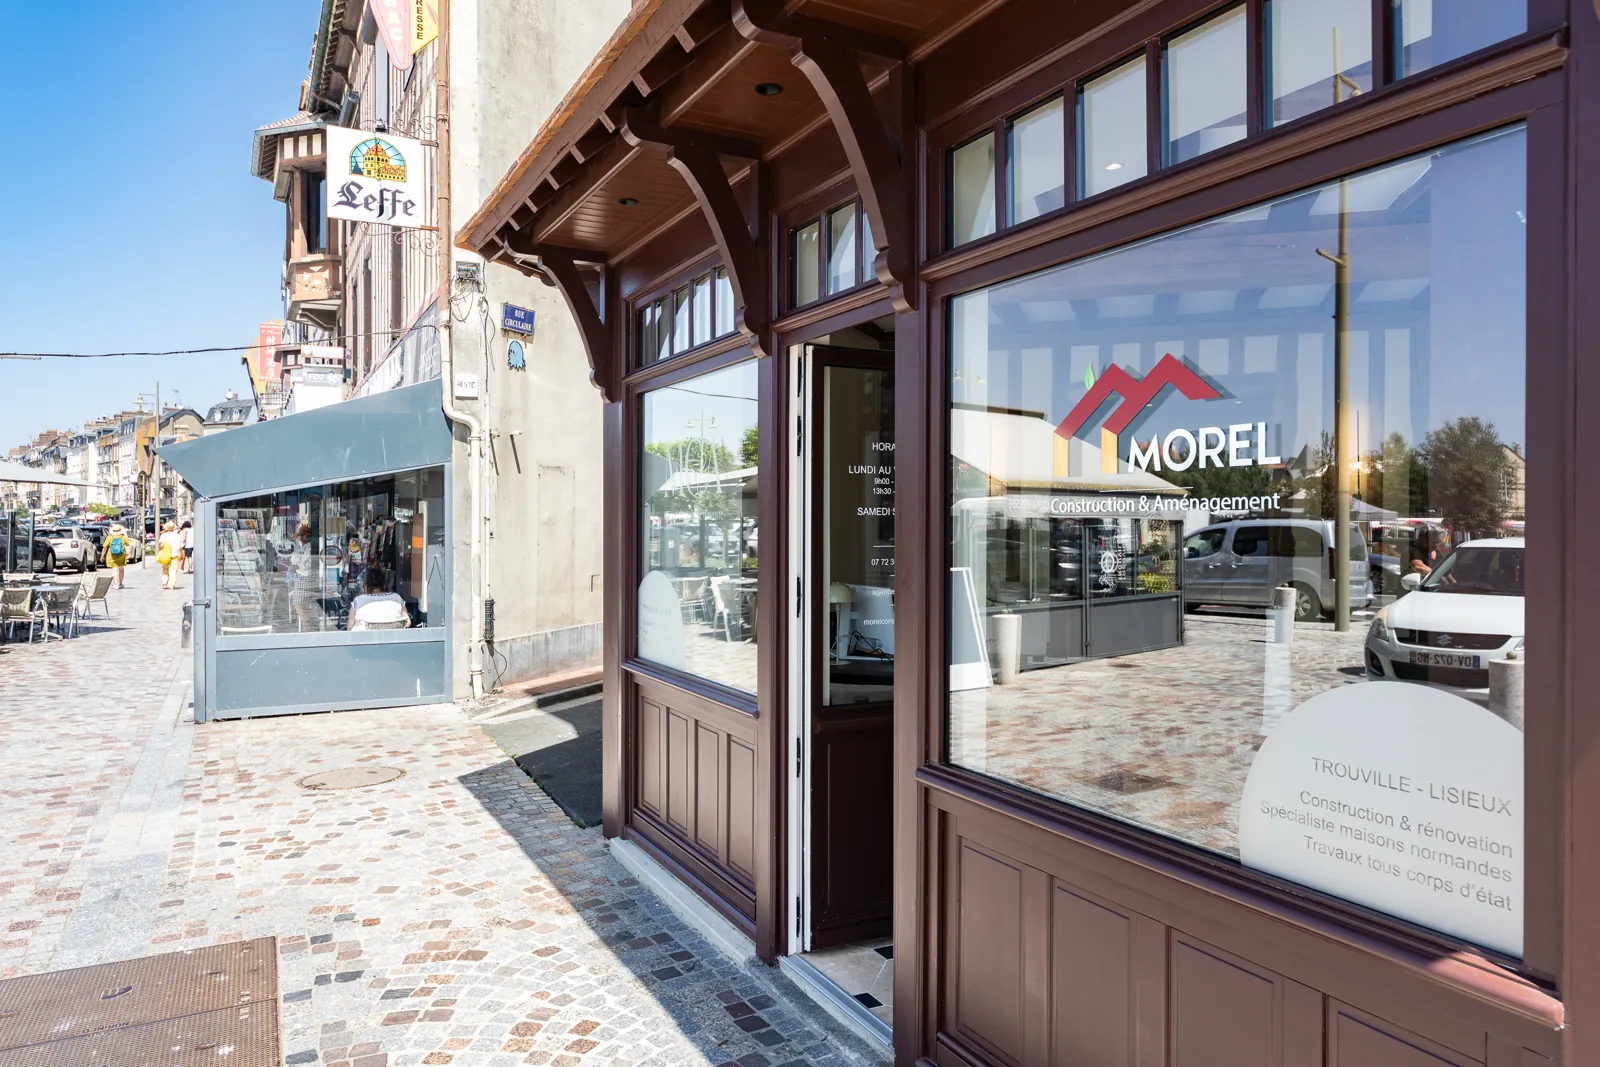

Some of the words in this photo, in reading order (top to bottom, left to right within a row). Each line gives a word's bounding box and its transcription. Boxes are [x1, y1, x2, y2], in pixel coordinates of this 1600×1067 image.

[333, 181, 417, 221] Leffe
[514, 309, 525, 319] RUE
[504, 318, 533, 331] CIRCULAIRE
[1128, 421, 1281, 473] MOREL
[848, 465, 876, 474] LUNDI
[878, 466, 891, 475] AU
[874, 477, 890, 485] 9h00
[872, 487, 892, 495] 13h30
[857, 507, 891, 516] SAMEDI
[1051, 497, 1135, 515] Construction
[1139, 495, 1150, 512] &
[1153, 492, 1281, 514] Aménagement
[871, 558, 880, 566] 07
[880, 558, 889, 566] 72
[1311, 756, 1411, 794] TROUVILLE
[1429, 782, 1512, 817] LISIEUX
[1300, 790, 1394, 828] Construction
[1399, 815, 1412, 832] &
[1417, 821, 1513, 858] rénovation
[1260, 800, 1335, 833] Spécialiste
[1340, 823, 1405, 853] maisons
[1410, 840, 1513, 883] normandes
[1304, 835, 1363, 866] Travaux
[1368, 853, 1401, 877] tous
[1406, 868, 1454, 893] corps
